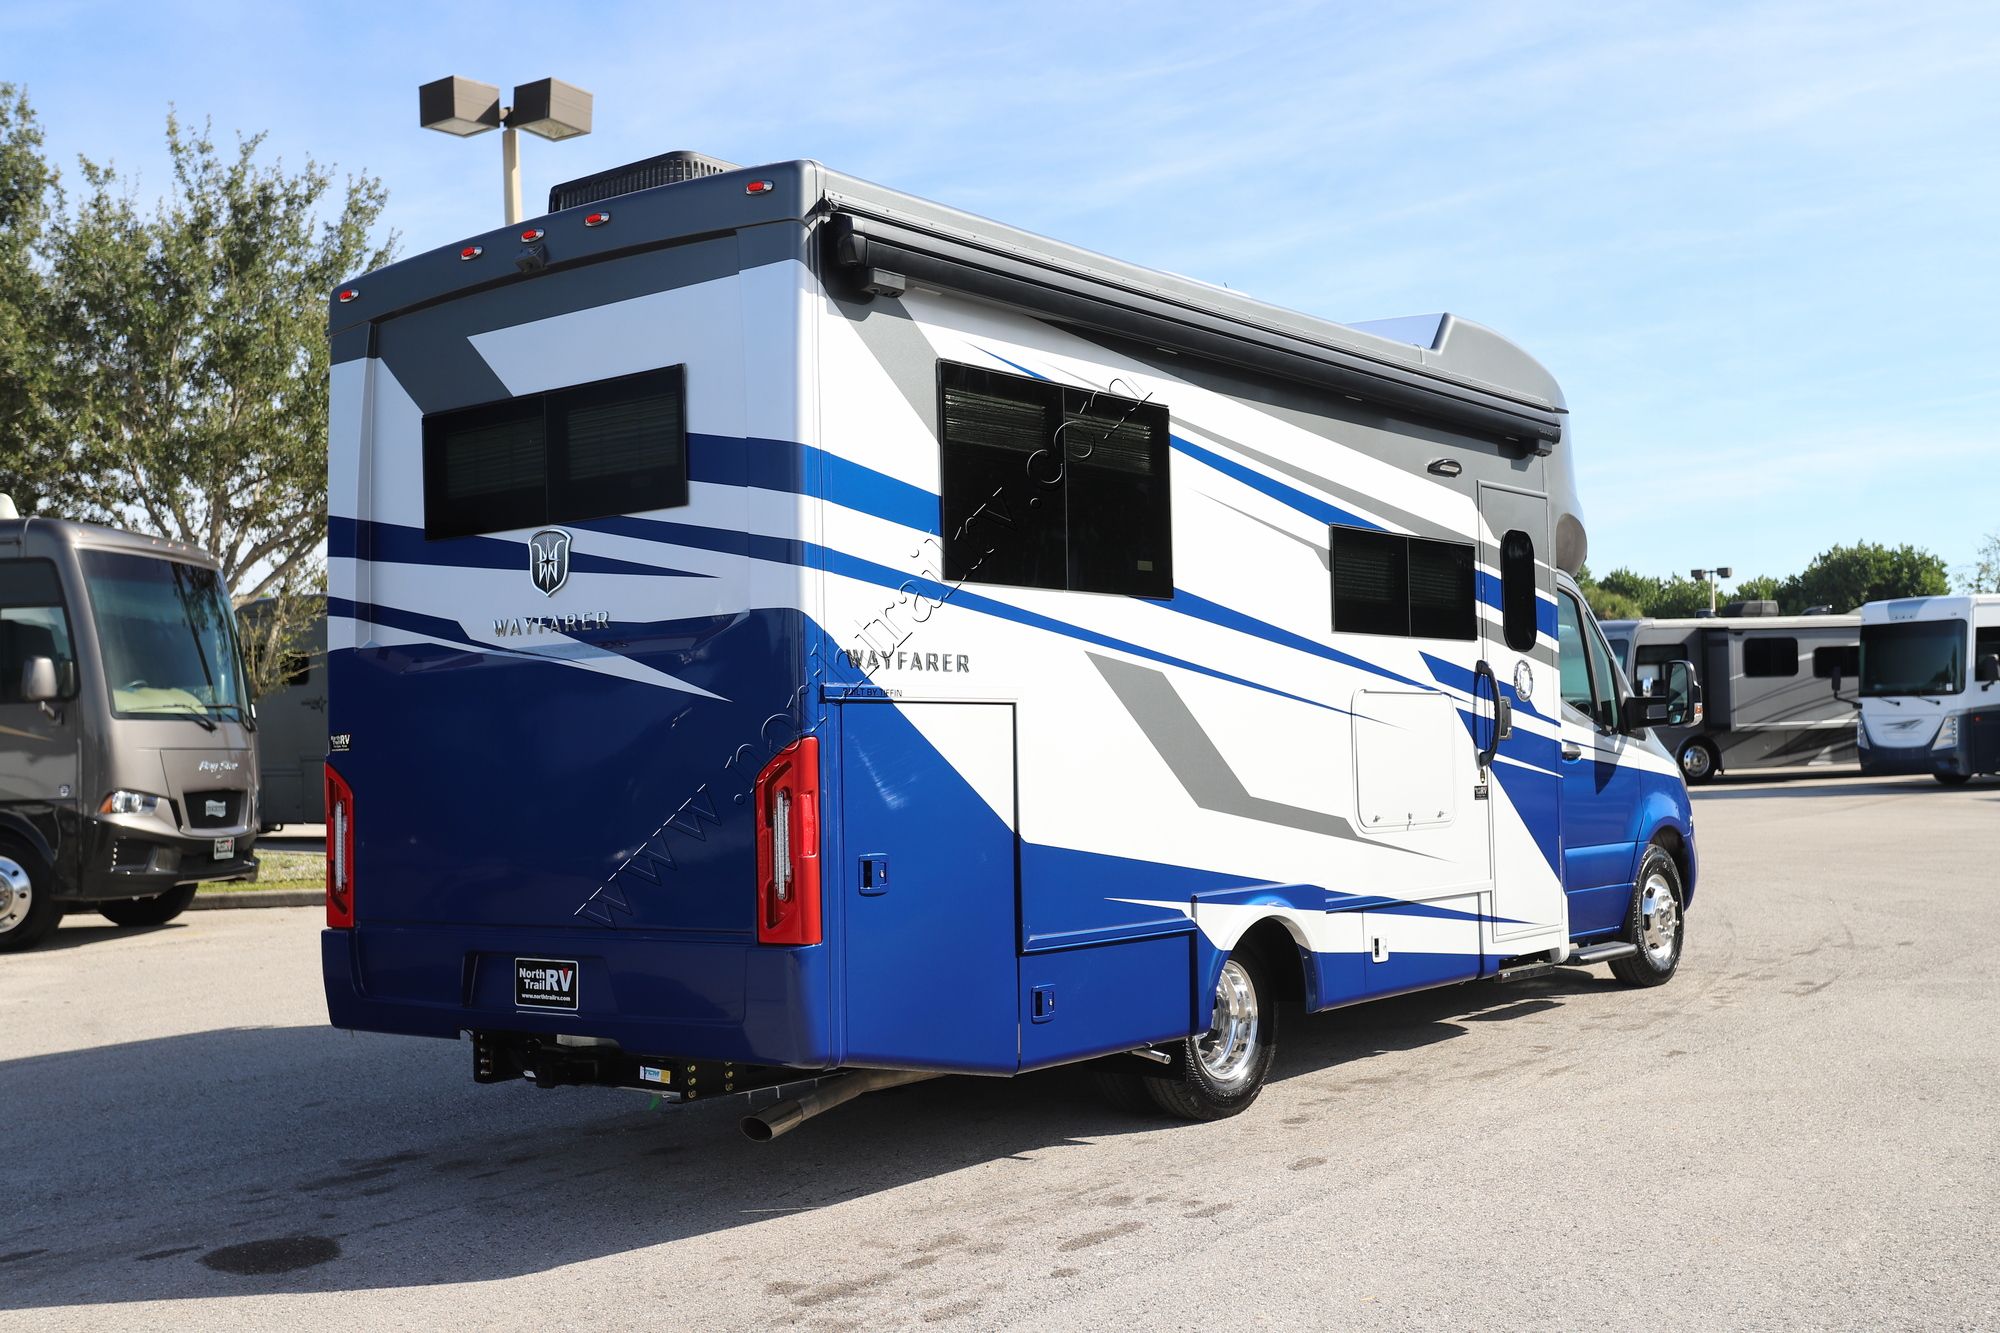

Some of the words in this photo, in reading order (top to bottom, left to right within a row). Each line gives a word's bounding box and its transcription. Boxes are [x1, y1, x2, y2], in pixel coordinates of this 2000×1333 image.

[492, 610, 609, 637] WAYFARER
[845, 648, 970, 674] WAYFARER
[866, 688, 878, 696] BY
[880, 688, 903, 697] TIFFIN
[519, 967, 545, 979] North
[524, 978, 545, 990] Trail
[545, 968, 573, 992] RV
[521, 993, 571, 1002] www.northtrailrv.com
